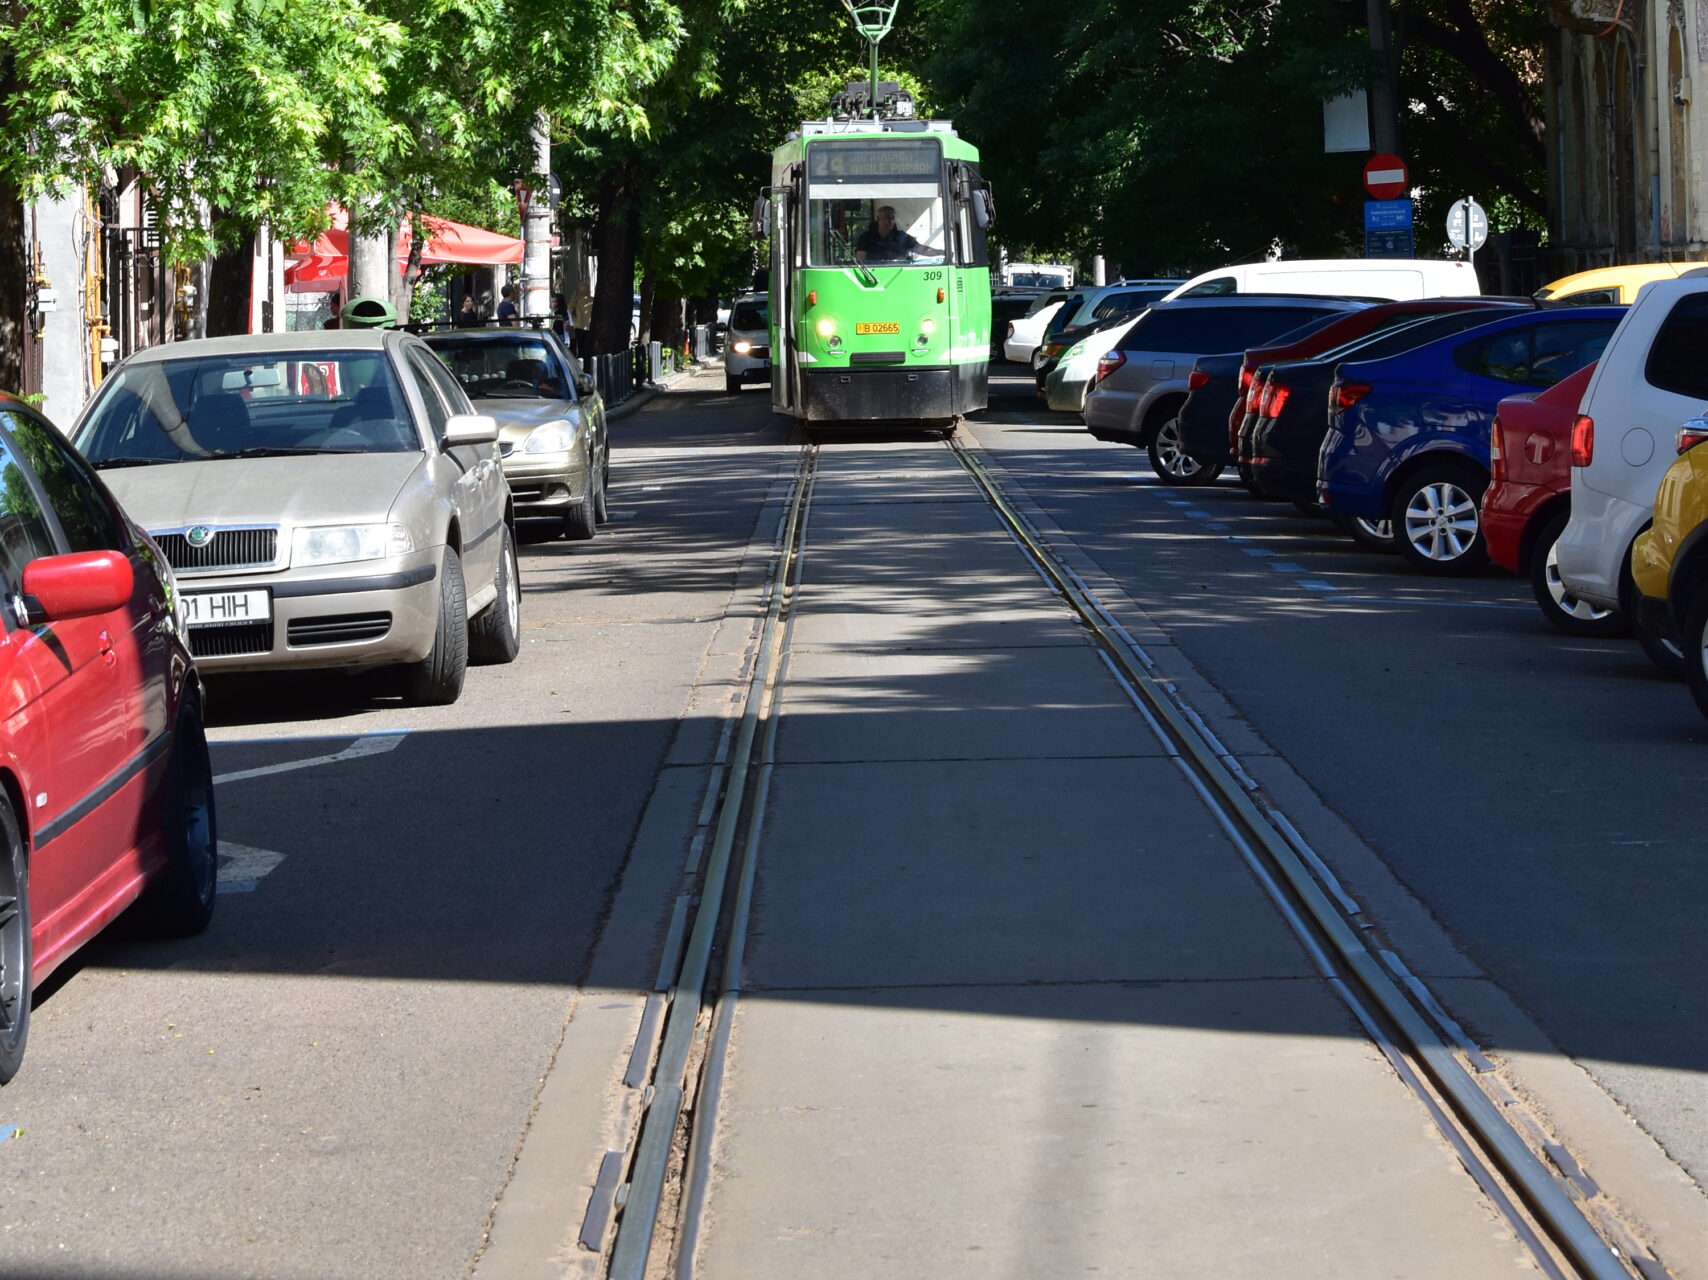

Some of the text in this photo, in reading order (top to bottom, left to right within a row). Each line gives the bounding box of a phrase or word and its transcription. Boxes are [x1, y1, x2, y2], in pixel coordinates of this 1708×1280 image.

[815, 152, 845, 176] 24
[923, 271, 942, 281] 309
[864, 323, 899, 333] B 02665
[210, 594, 249, 619] HIH
